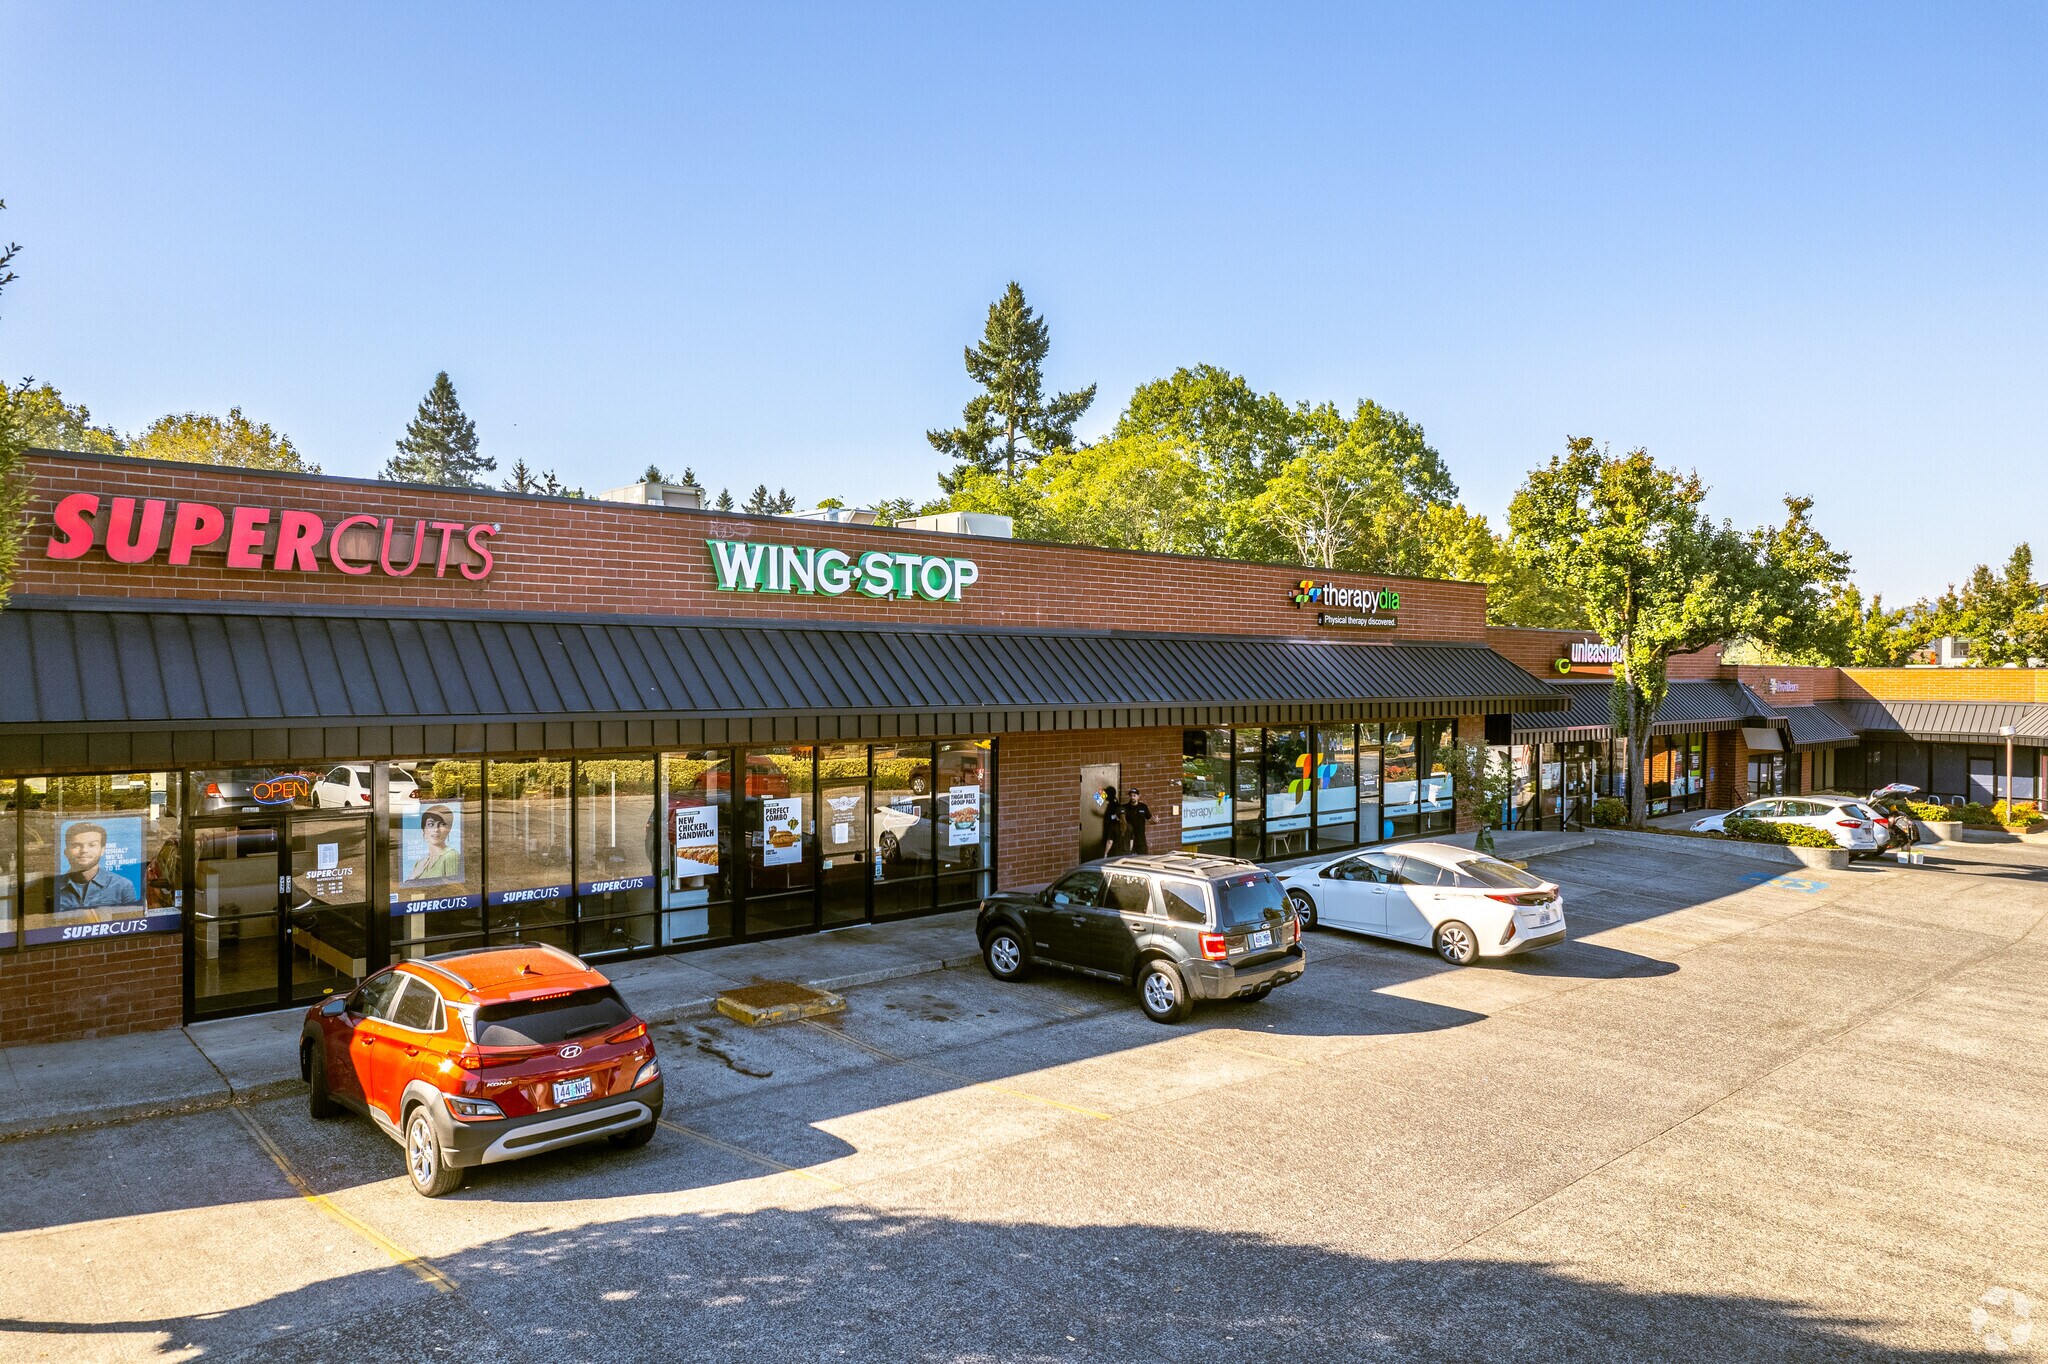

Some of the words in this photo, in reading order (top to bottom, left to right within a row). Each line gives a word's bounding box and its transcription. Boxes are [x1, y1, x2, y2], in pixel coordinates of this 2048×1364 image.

[46, 493, 498, 581] SUPERCUTS
[1323, 582, 1400, 614] therapydia
[1324, 615, 1347, 625] Physical
[1348, 617, 1367, 627] therapy
[253, 781, 308, 799] OPEN
[766, 806, 789, 815] PERFECT
[1183, 805, 1224, 818] therapydia
[678, 816, 694, 825] NEW
[766, 814, 787, 822] COMBO
[678, 822, 708, 832] CHICKEN
[678, 829, 714, 840] SANDWICH
[105, 847, 128, 855] USUAL?
[306, 867, 353, 879] SUPERCUTS
[591, 878, 644, 893] SUPERCUTS
[502, 887, 560, 902] SUPERCUTS
[406, 896, 467, 913] SUPERCUTS
[62, 919, 148, 939] SUPERCUTS
[486, 1080, 513, 1088] KONA
[555, 1085, 570, 1098] 144
